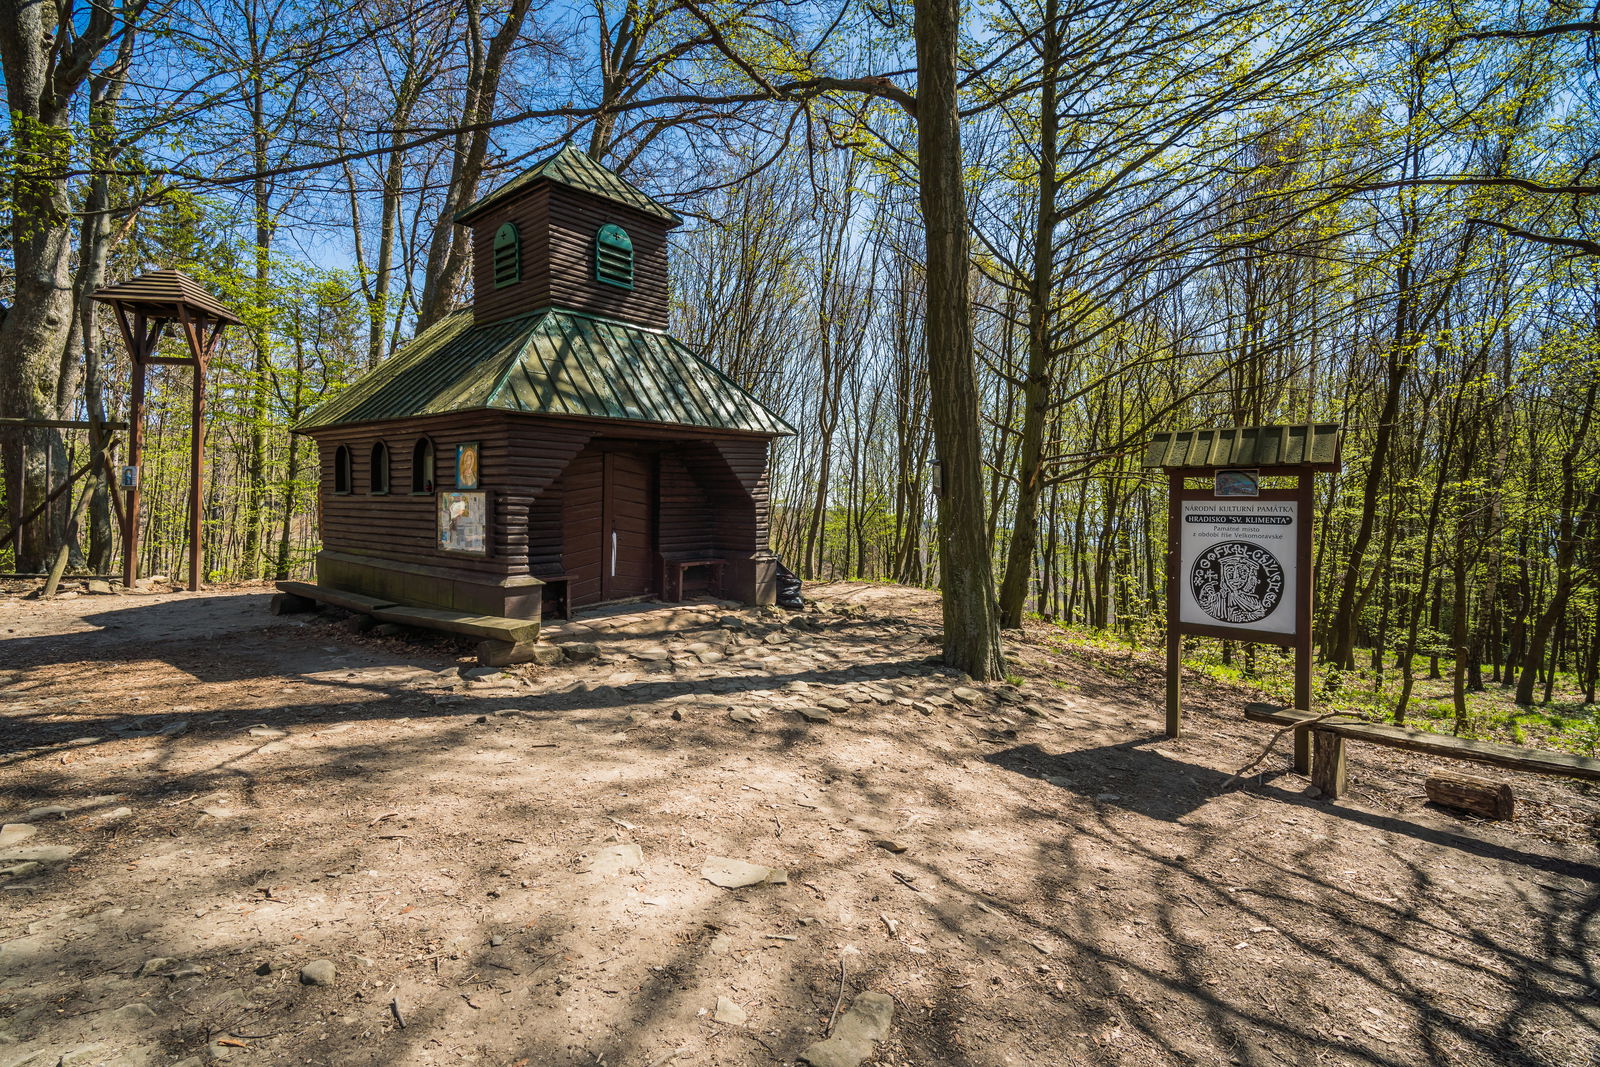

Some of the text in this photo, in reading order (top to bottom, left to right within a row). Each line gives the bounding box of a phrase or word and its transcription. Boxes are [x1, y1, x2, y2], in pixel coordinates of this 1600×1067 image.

[1218, 505, 1254, 513] KULTURNÍ
[1257, 505, 1294, 513] PAMÁTKA
[1188, 515, 1227, 523] HRADISKO
